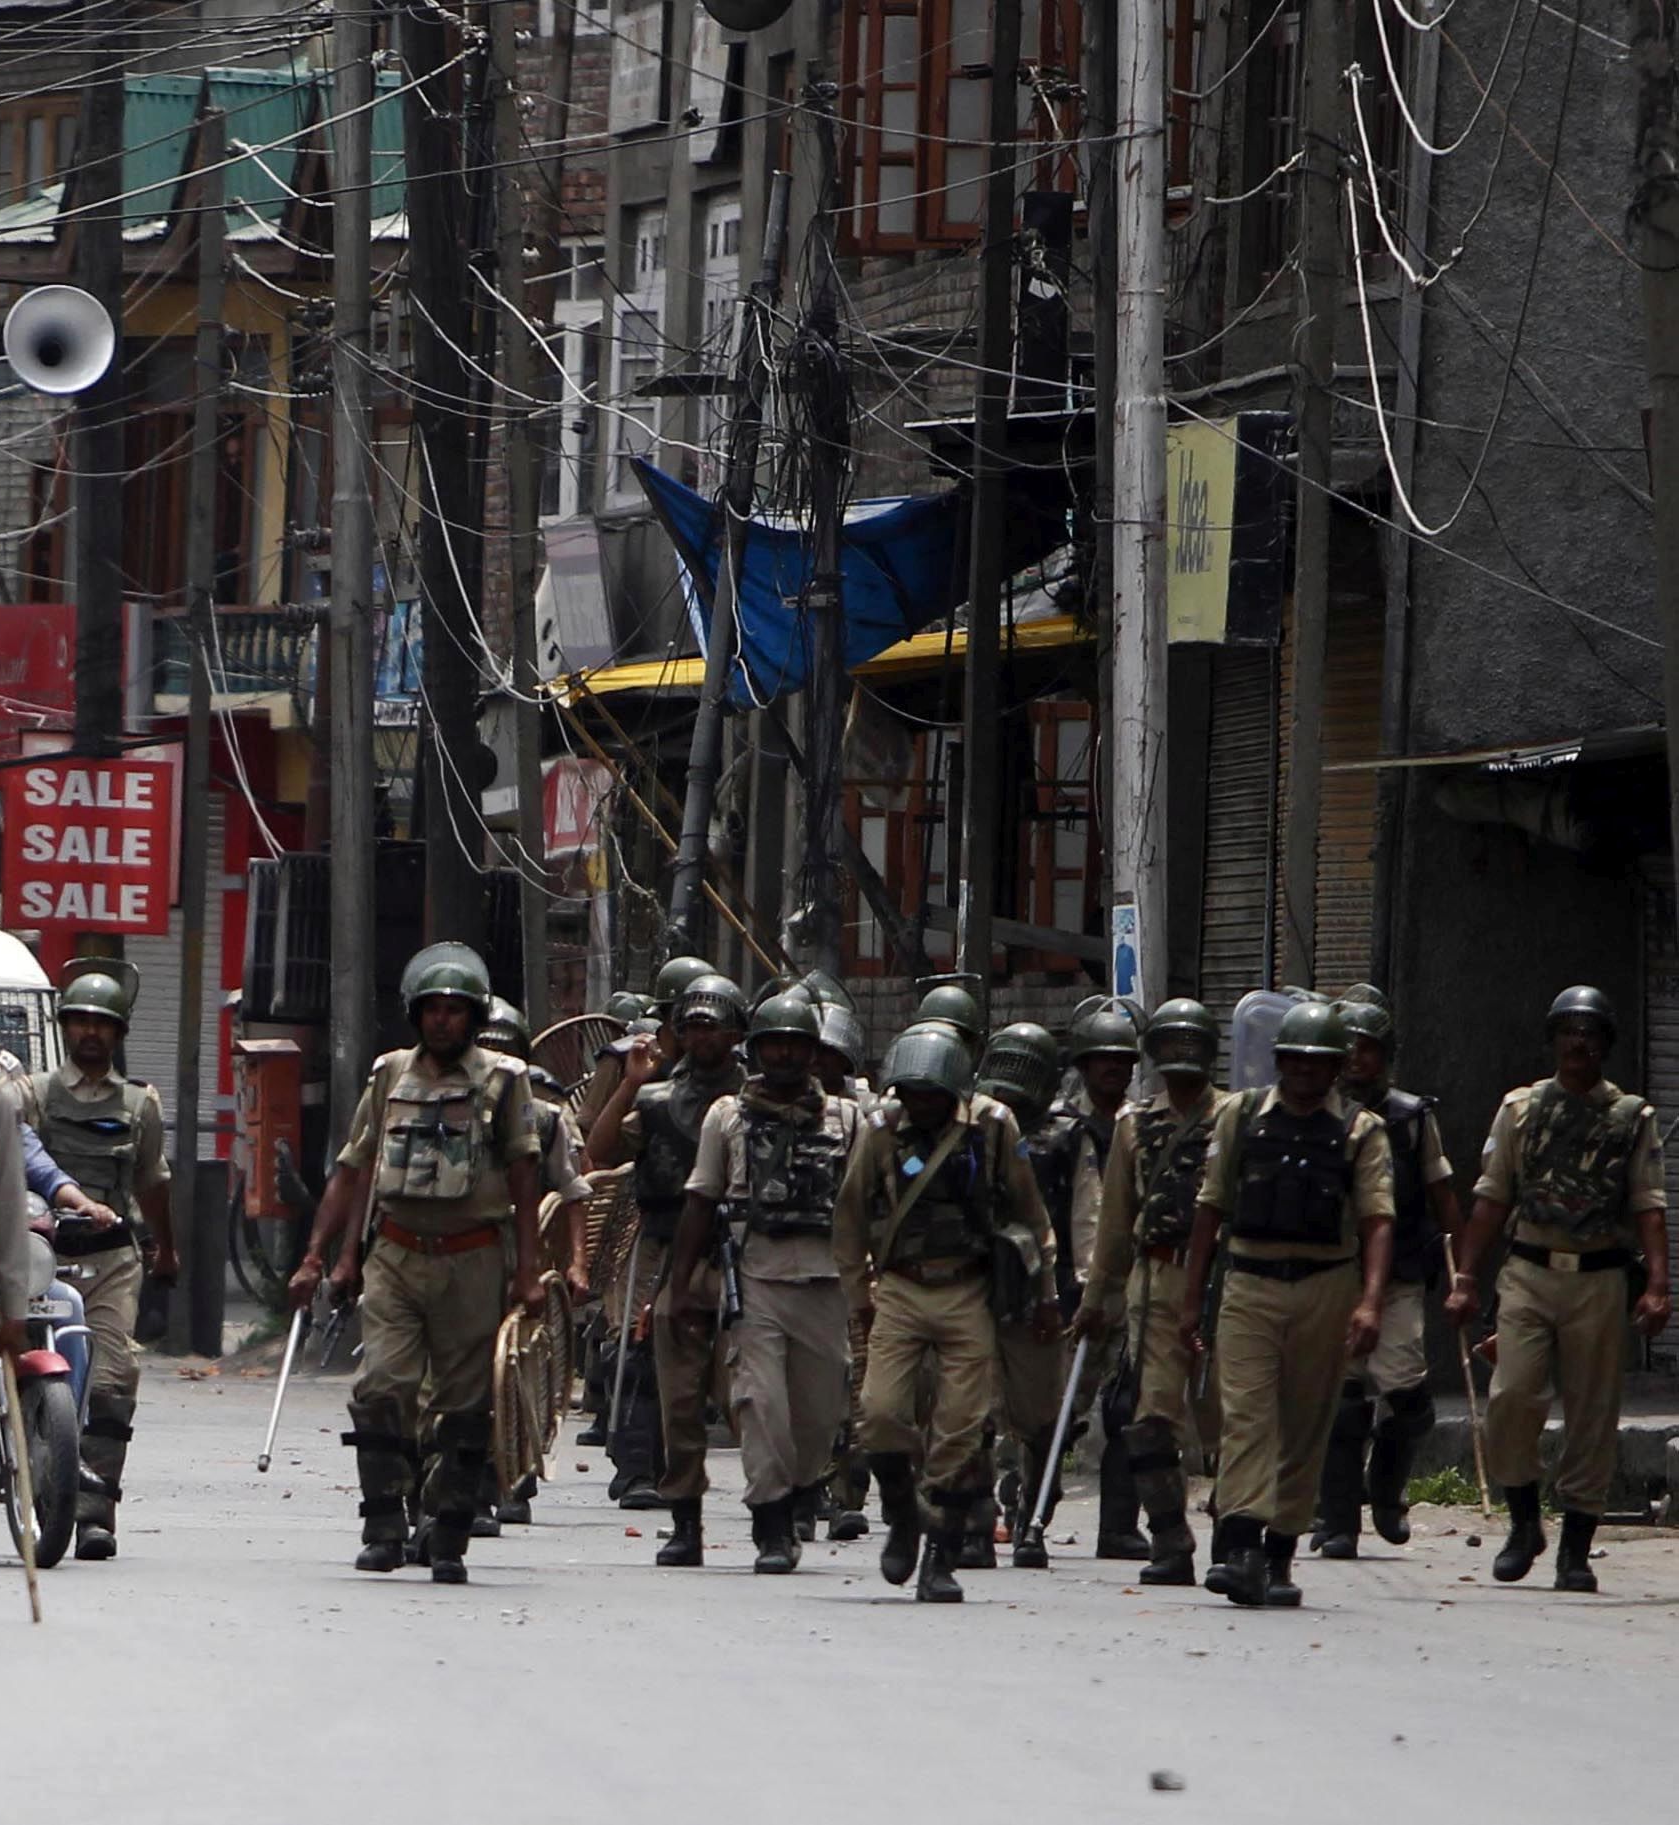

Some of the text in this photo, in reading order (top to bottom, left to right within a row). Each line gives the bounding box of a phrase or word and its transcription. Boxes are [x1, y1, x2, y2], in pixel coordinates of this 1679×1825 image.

[24, 768, 154, 810] SALE
[22, 823, 151, 866] SALE
[20, 880, 149, 922] SALE
